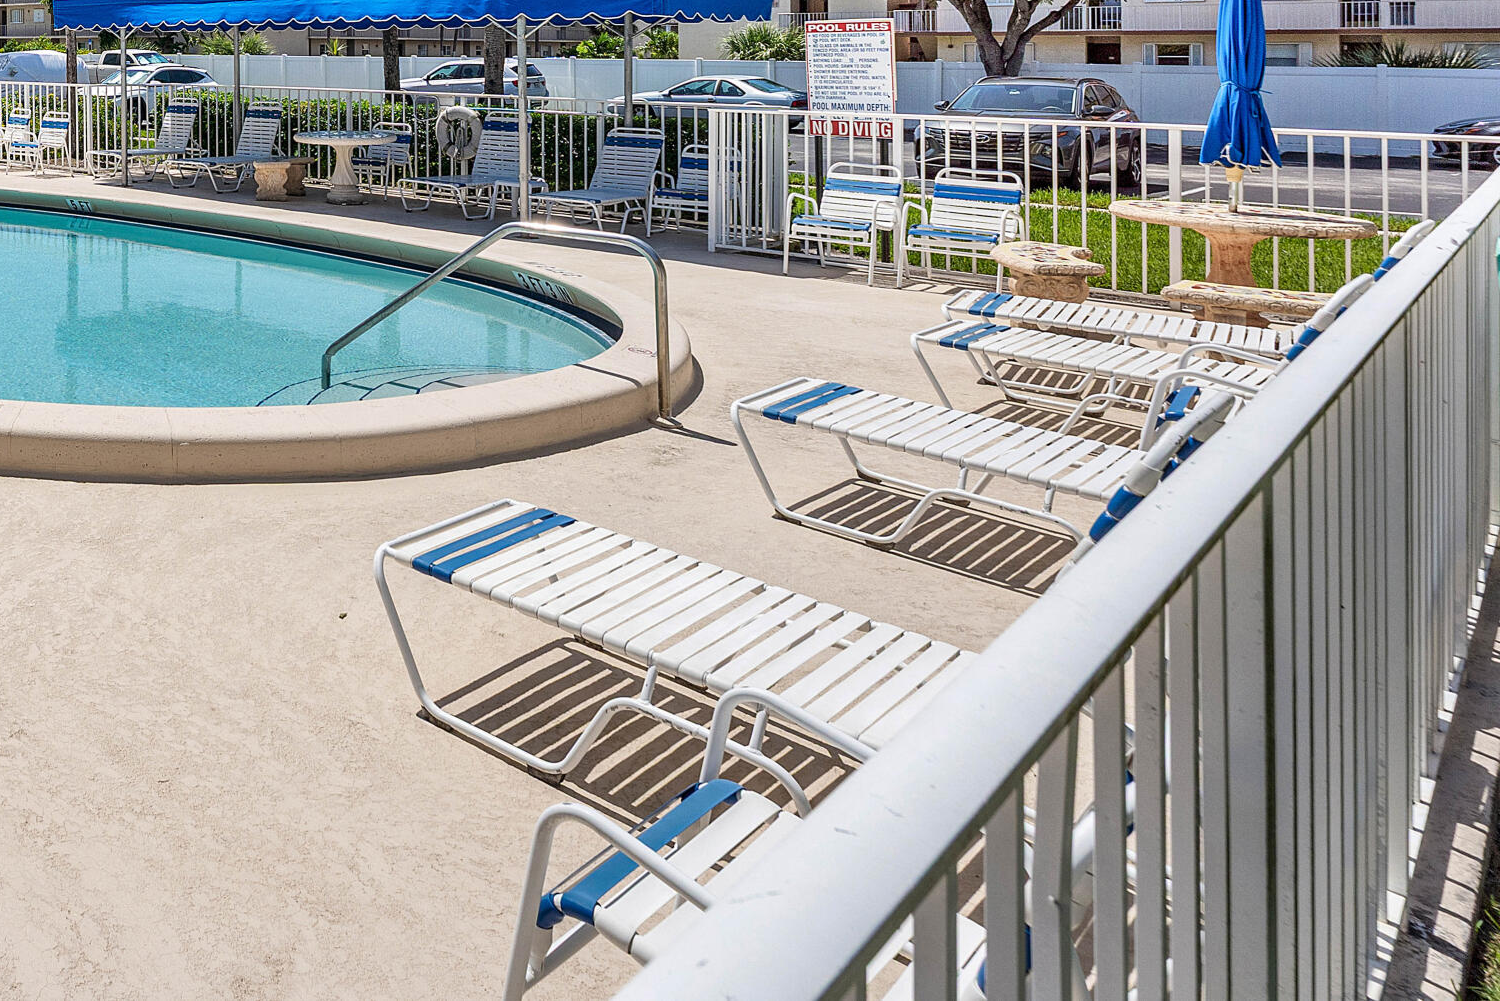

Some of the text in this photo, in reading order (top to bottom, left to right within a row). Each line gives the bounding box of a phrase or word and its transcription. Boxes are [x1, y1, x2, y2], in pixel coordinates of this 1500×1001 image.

[808, 22, 888, 32] POOL RULES
[812, 102, 829, 110] POOL
[866, 103, 891, 112] DEPTH:
[812, 120, 892, 138] NO DVING
[69, 200, 92, 212] 5 FT
[518, 272, 574, 304] 3 FT 3 IN
